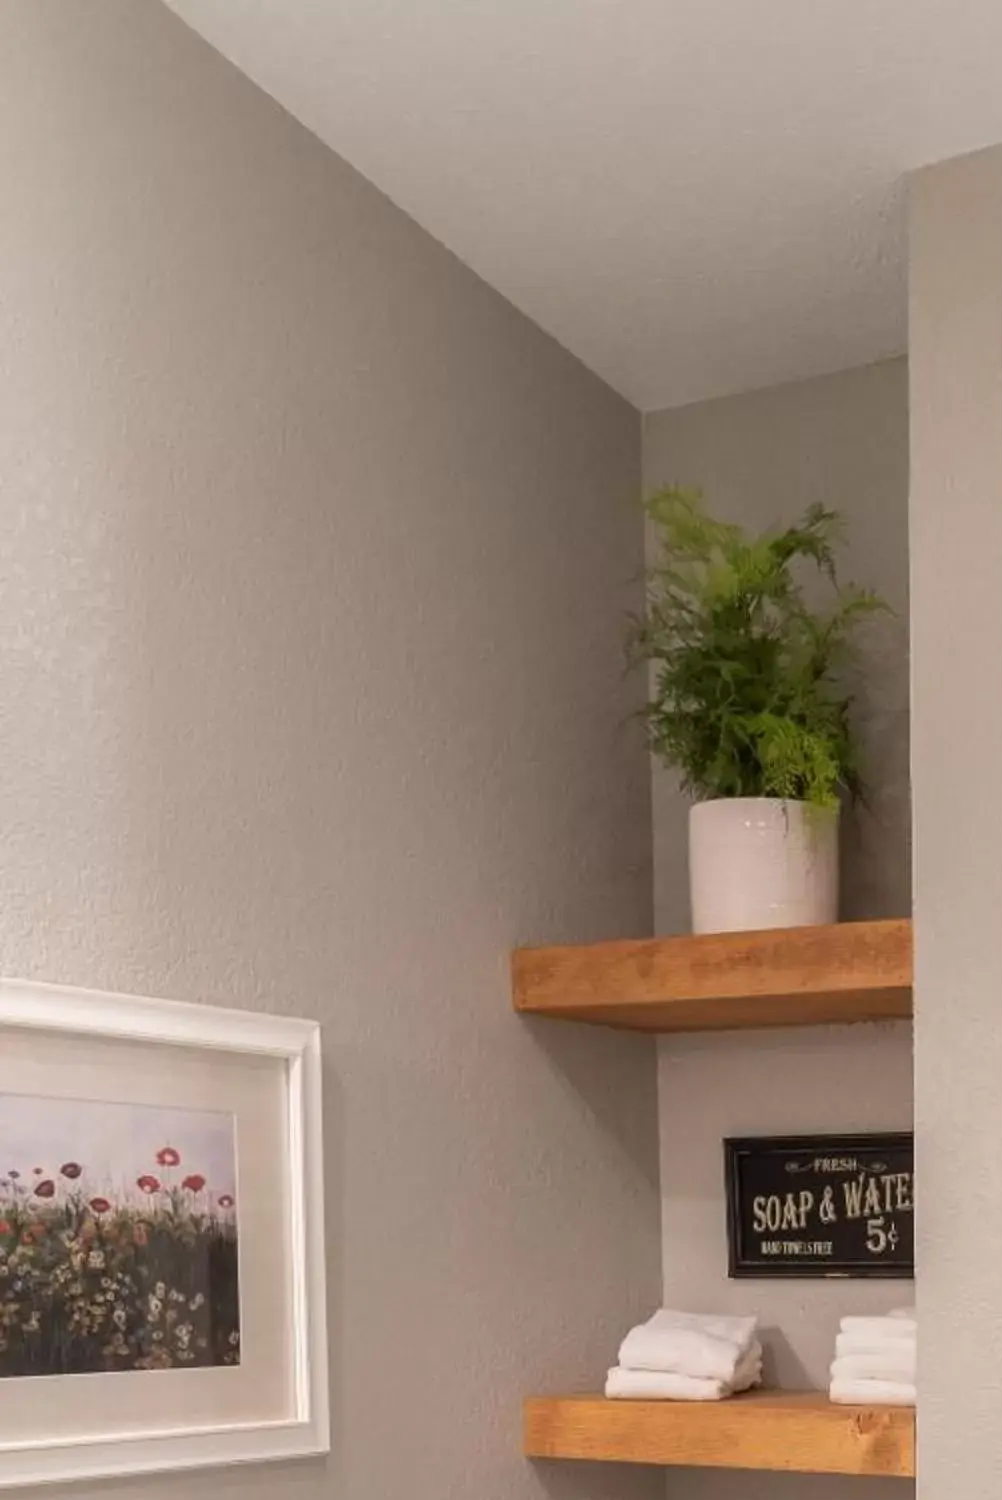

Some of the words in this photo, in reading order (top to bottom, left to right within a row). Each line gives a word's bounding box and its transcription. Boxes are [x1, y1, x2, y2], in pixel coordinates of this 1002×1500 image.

[814, 1158, 857, 1172] FRESH
[753, 1190, 814, 1232] SOAP
[819, 1185, 837, 1224] &
[843, 1172, 914, 1218] WATE
[866, 1216, 900, 1252] 5¢
